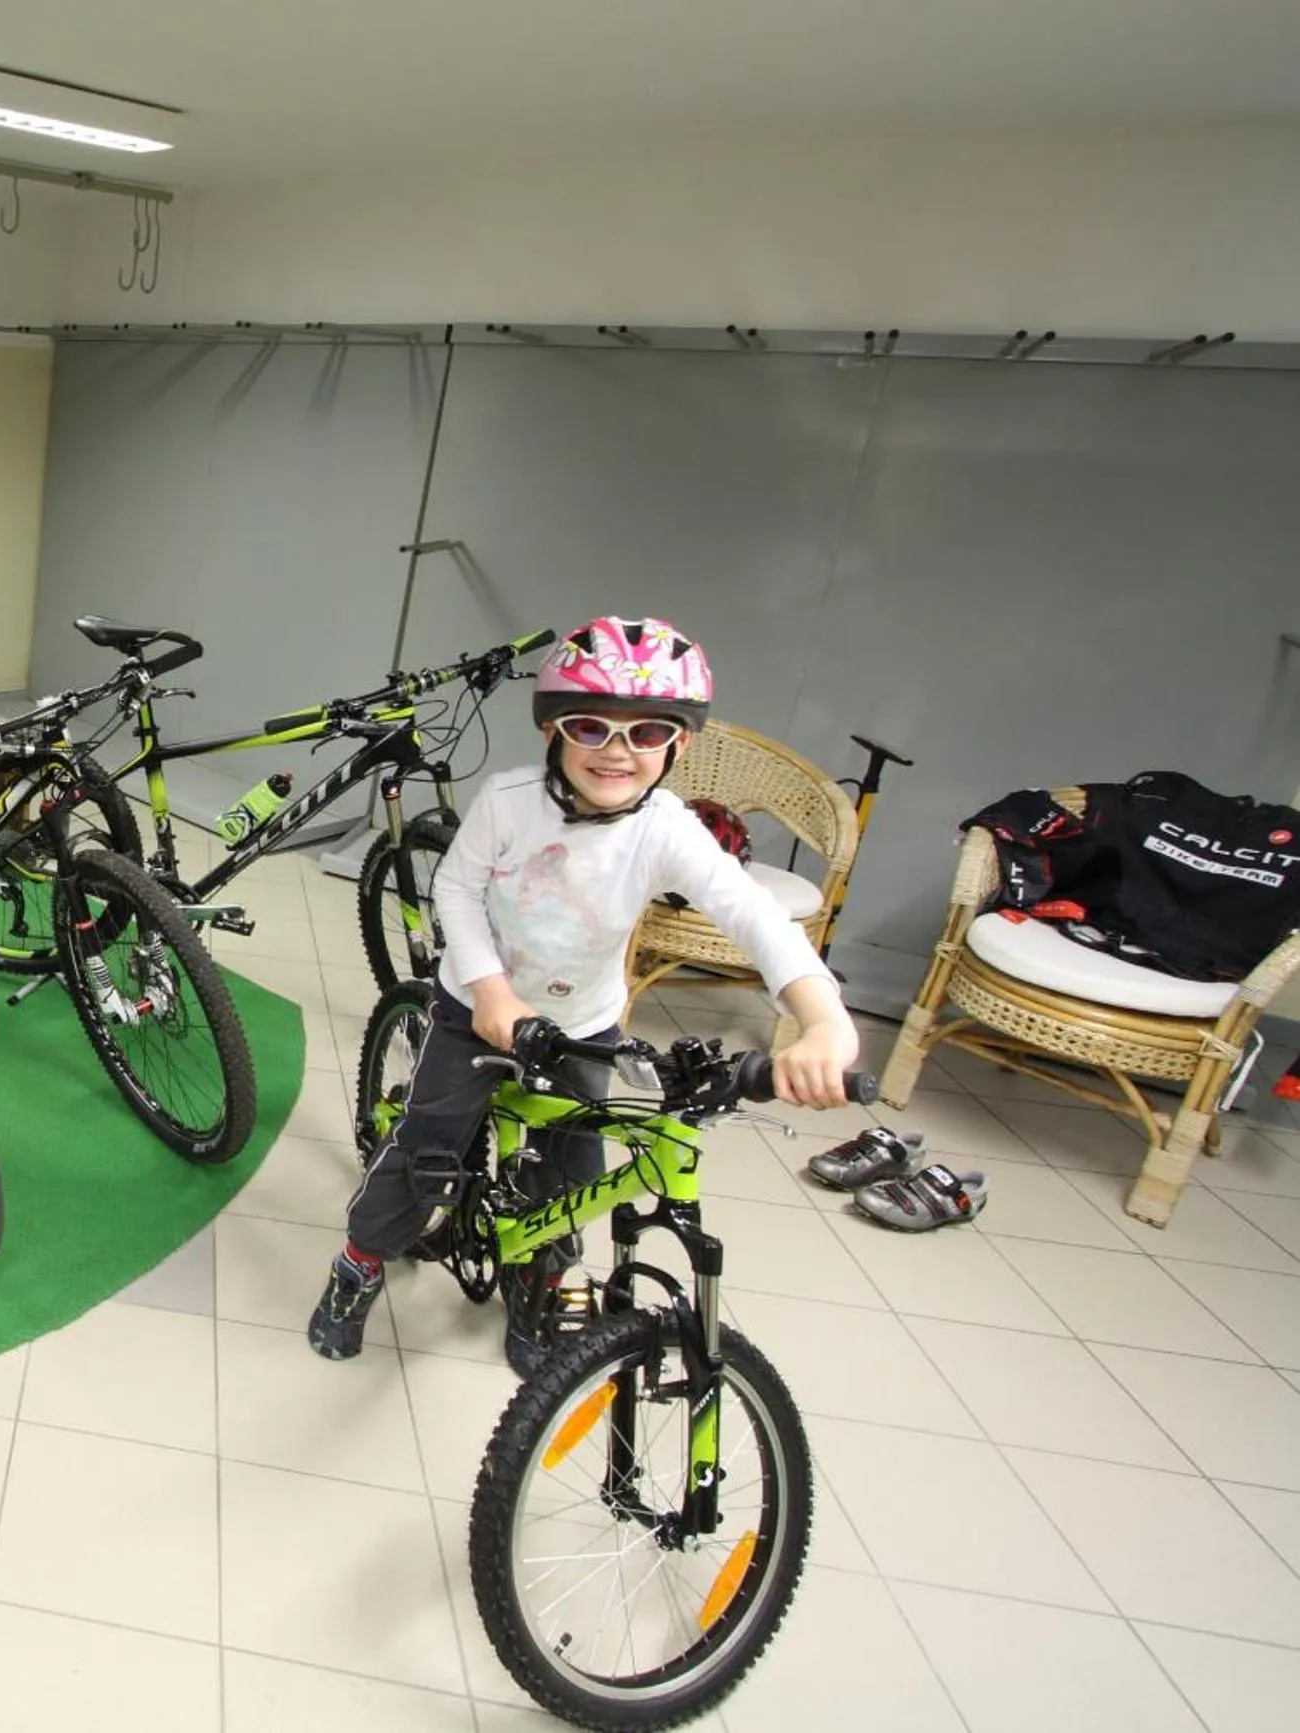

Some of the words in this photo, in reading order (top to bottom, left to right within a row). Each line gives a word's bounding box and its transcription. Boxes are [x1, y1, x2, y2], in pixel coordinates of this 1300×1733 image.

[233, 761, 352, 862] SCOTT
[1158, 821, 1300, 867] CALCIT
[1217, 865, 1279, 885] TEAM
[523, 1162, 635, 1239] SCOTT
